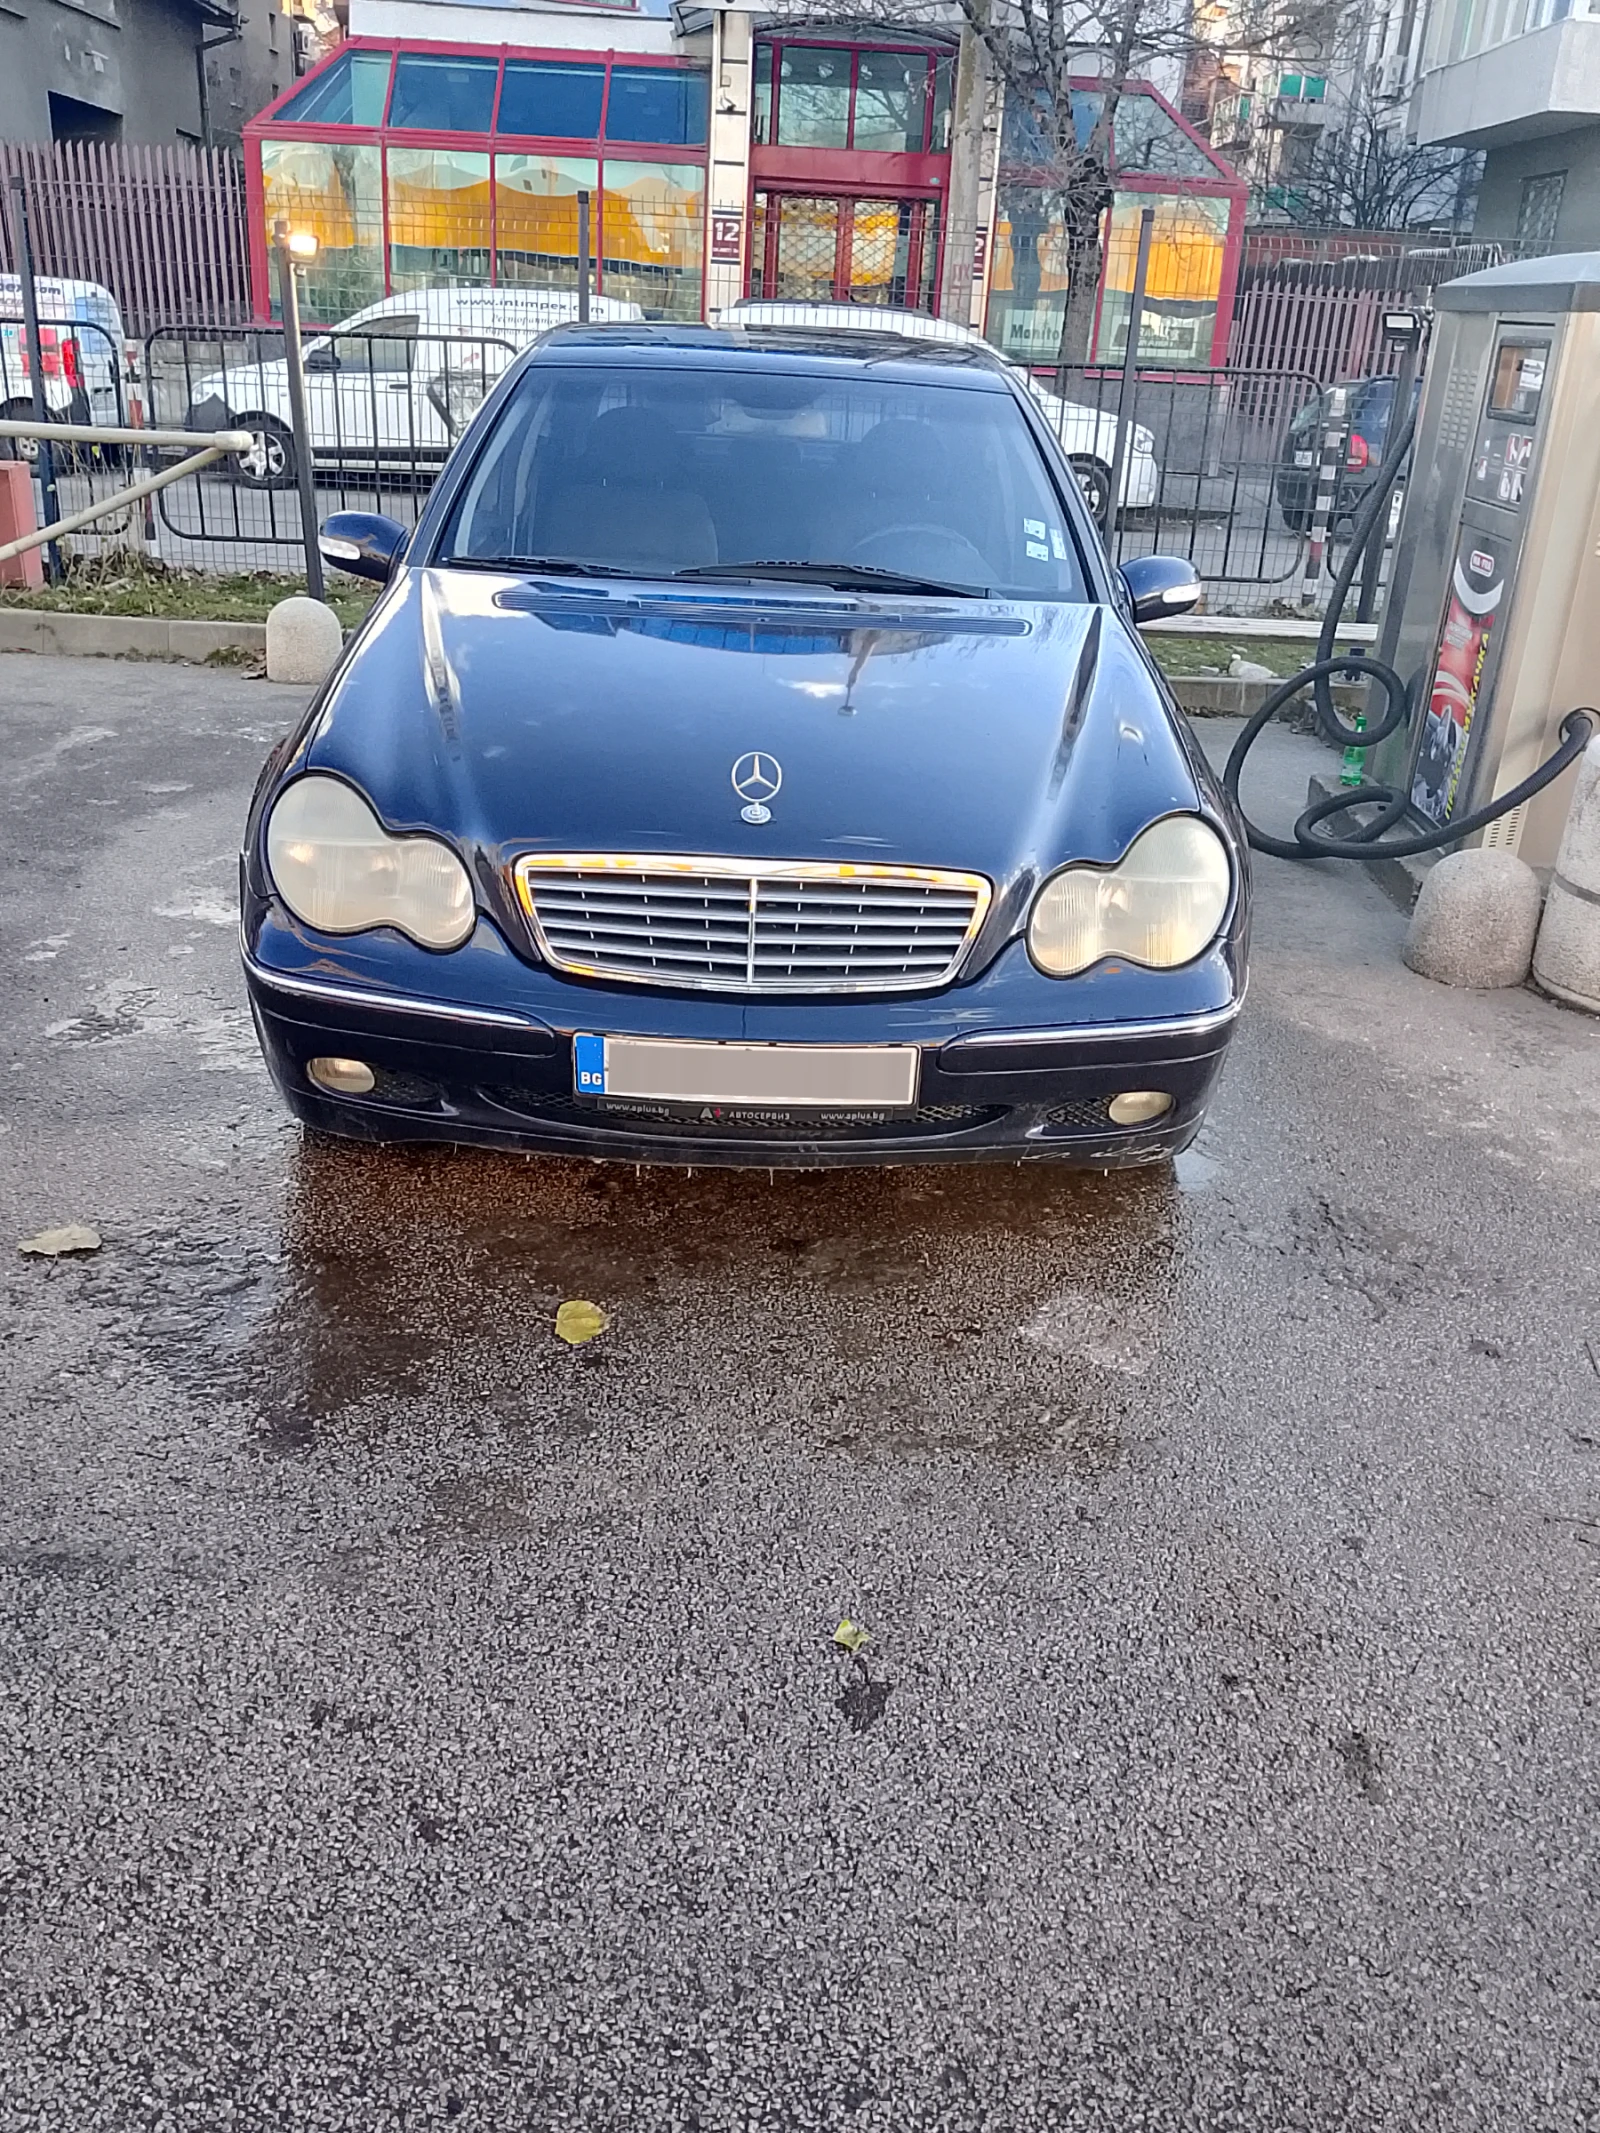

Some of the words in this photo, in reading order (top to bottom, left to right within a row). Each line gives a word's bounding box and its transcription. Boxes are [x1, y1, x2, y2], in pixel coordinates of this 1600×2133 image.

[715, 222, 740, 242] 12
[456, 298, 605, 315] www.intimpex.cm
[580, 1071, 602, 1086] BG
[606, 1102, 670, 1116] www.aplus.bg
[728, 1111, 790, 1120] АВТОСЕРВИЗ
[820, 1111, 885, 1121] www.aplus.bg
